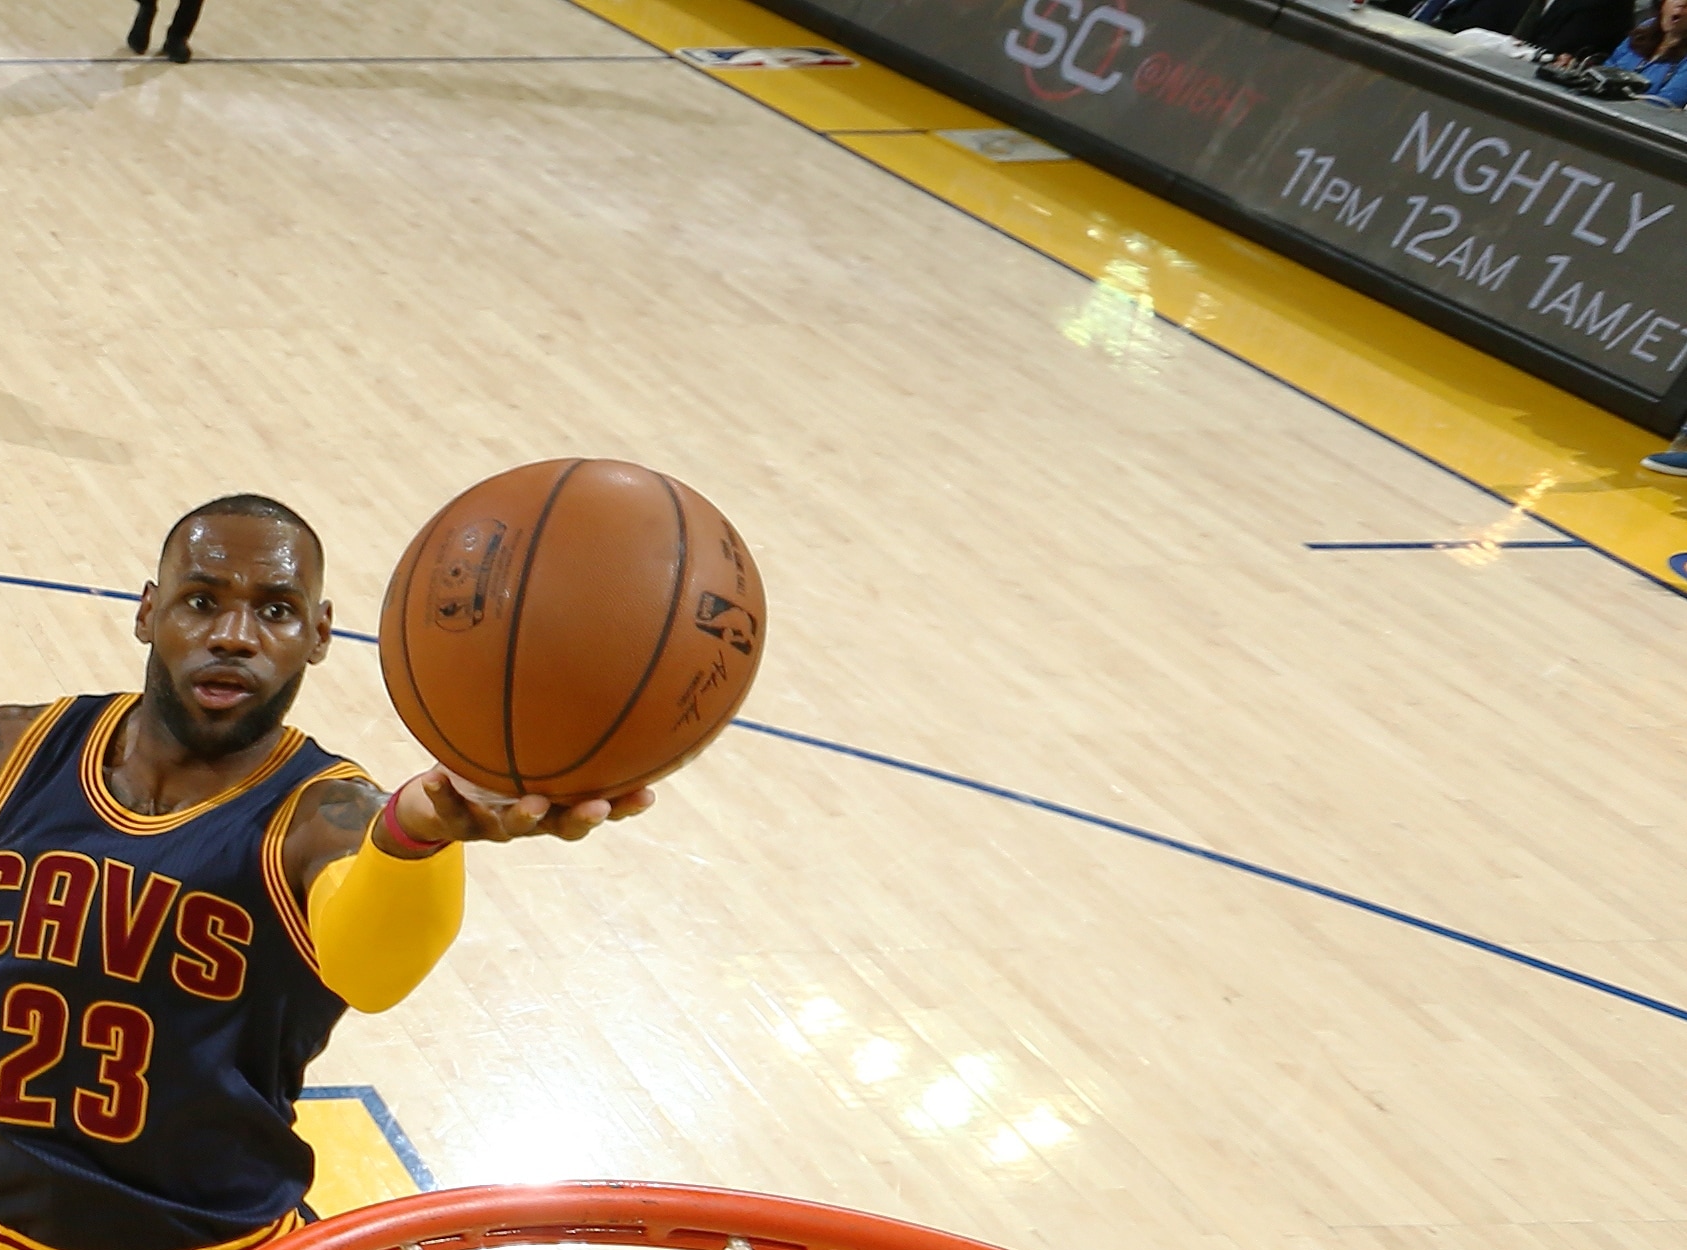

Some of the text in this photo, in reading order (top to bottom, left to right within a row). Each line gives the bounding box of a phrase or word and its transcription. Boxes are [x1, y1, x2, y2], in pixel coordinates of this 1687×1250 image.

[1004, 0, 1145, 94] SC
[1281, 148, 1383, 233] 11PM
[1391, 196, 1520, 292] 12AM
[1391, 111, 1675, 255] NIGHTLY
